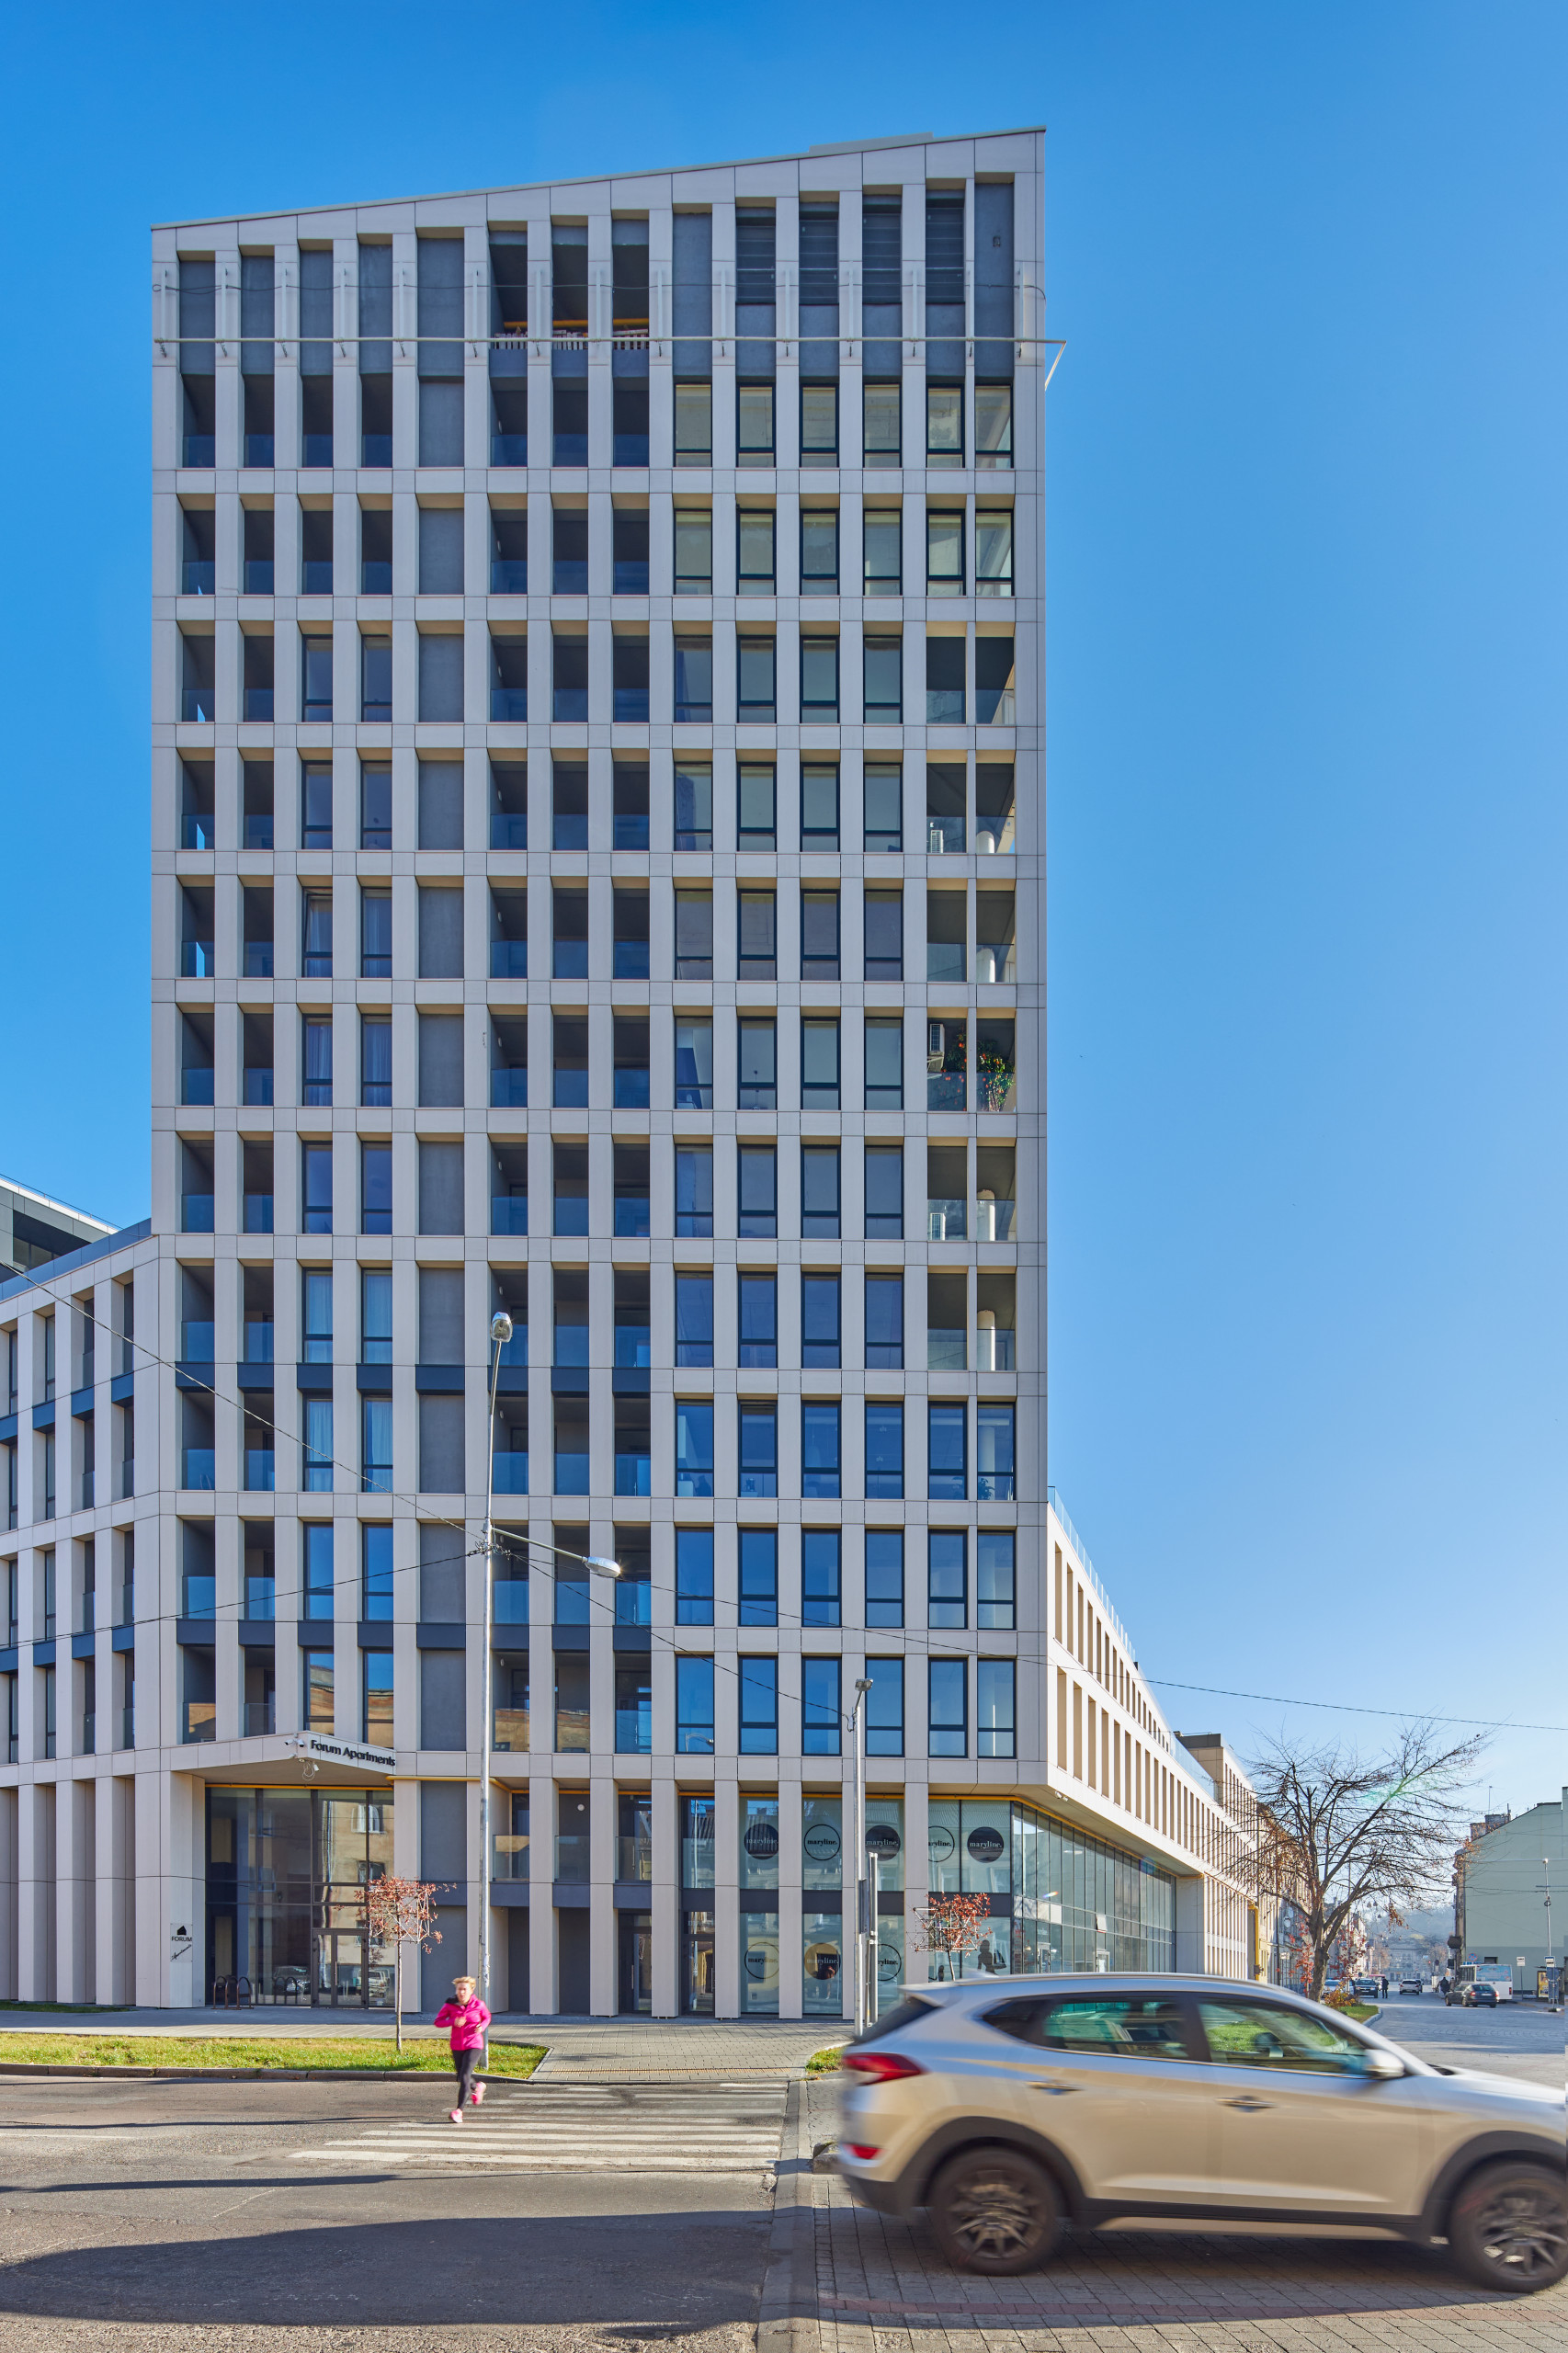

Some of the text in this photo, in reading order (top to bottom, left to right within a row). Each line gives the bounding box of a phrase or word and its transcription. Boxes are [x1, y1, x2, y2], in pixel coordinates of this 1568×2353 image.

[311, 1739, 395, 1767] Forum Apartments
[807, 1838, 837, 1847] maryline.
[928, 1840, 951, 1848] aryline.
[970, 1840, 1002, 1848] maryline.
[878, 1959, 898, 1967] ryline.
